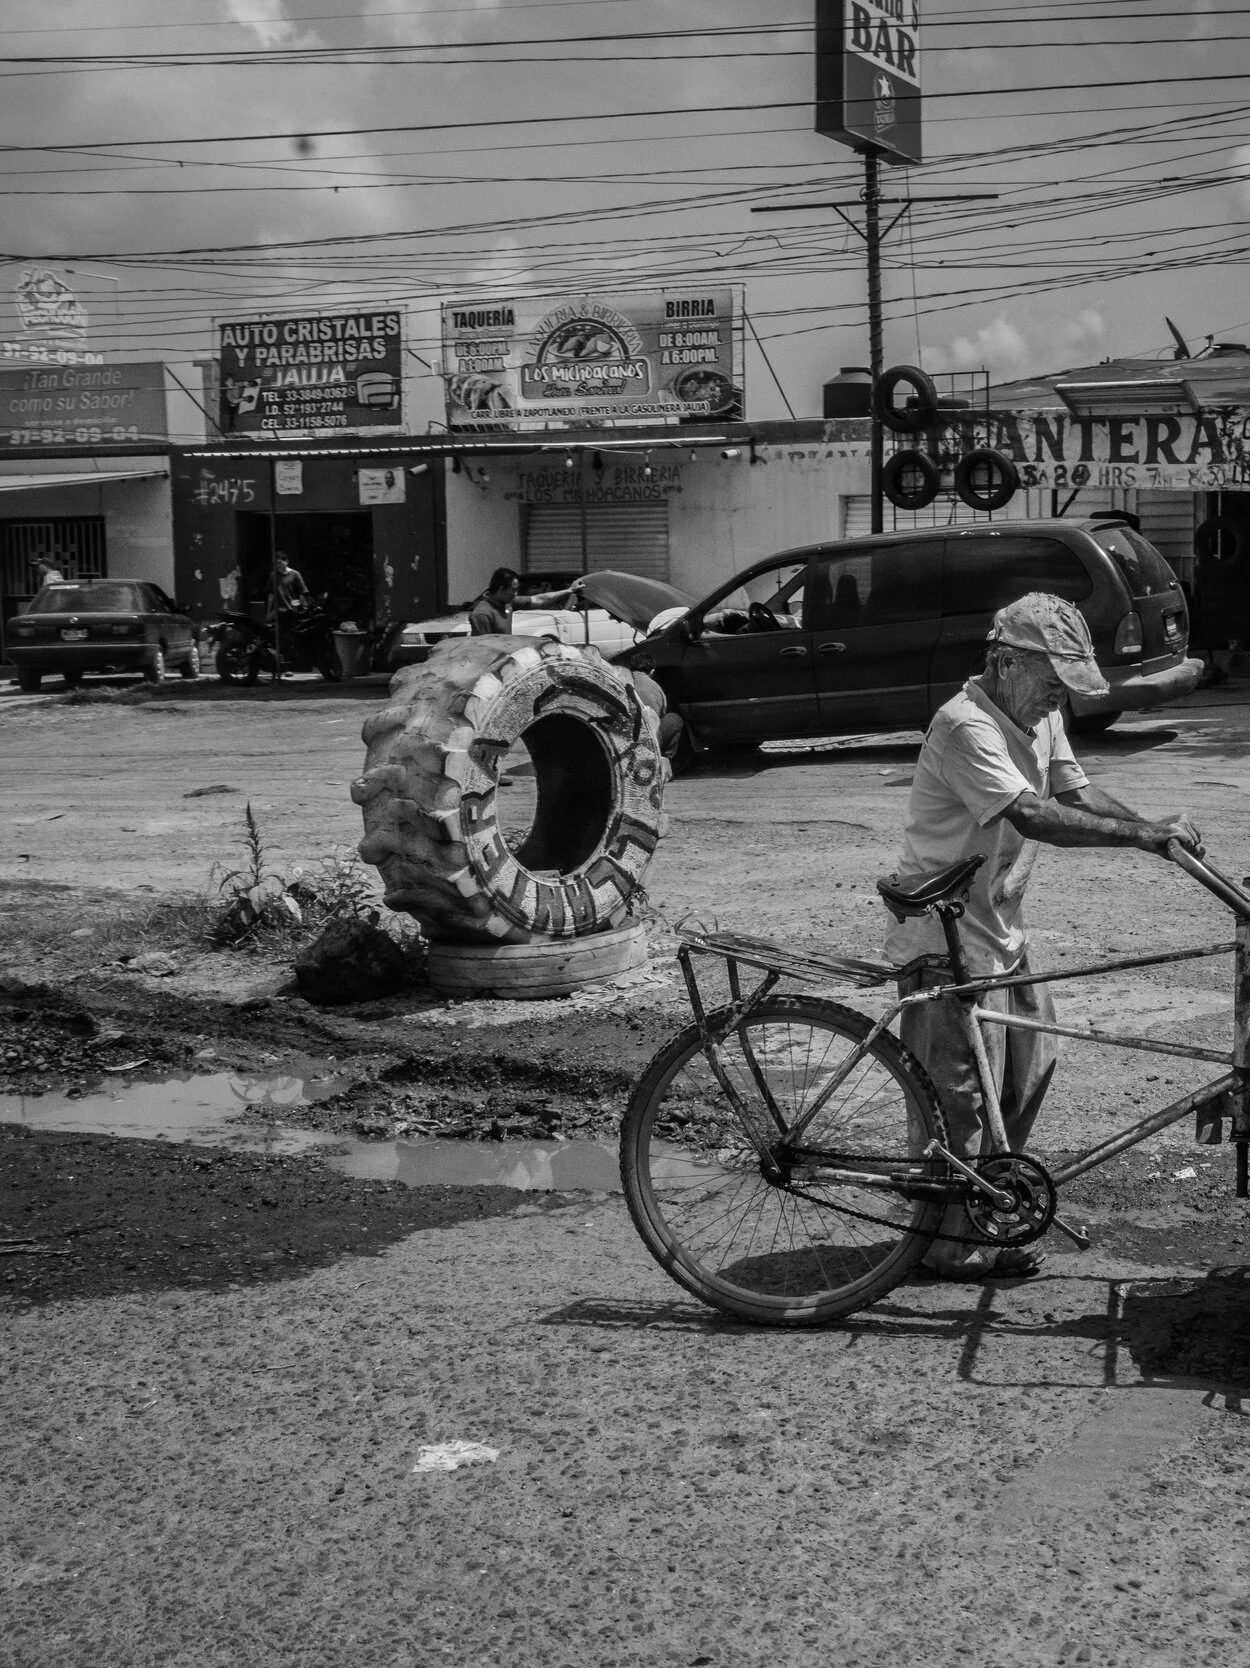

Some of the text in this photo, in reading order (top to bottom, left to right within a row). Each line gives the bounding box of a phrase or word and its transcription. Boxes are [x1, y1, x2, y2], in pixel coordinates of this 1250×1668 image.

[851, 1, 917, 79] BAR
[665, 298, 715, 318] BIRRIA
[453, 306, 514, 329] TAQUERÍA
[222, 314, 399, 347] AUTO CRISTALES
[659, 333, 674, 347] DE
[235, 338, 386, 368] Y PARABRISAS
[662, 350, 671, 364] A
[62, 367, 122, 388] Grande
[524, 366, 550, 383] LOS
[9, 389, 134, 413] como su Sabor!
[262, 392, 283, 402] TEL.
[620, 404, 629, 414] LA
[631, 402, 680, 414] GASOLINERA
[261, 418, 283, 429] CEL.
[526, 489, 553, 502] LOS
